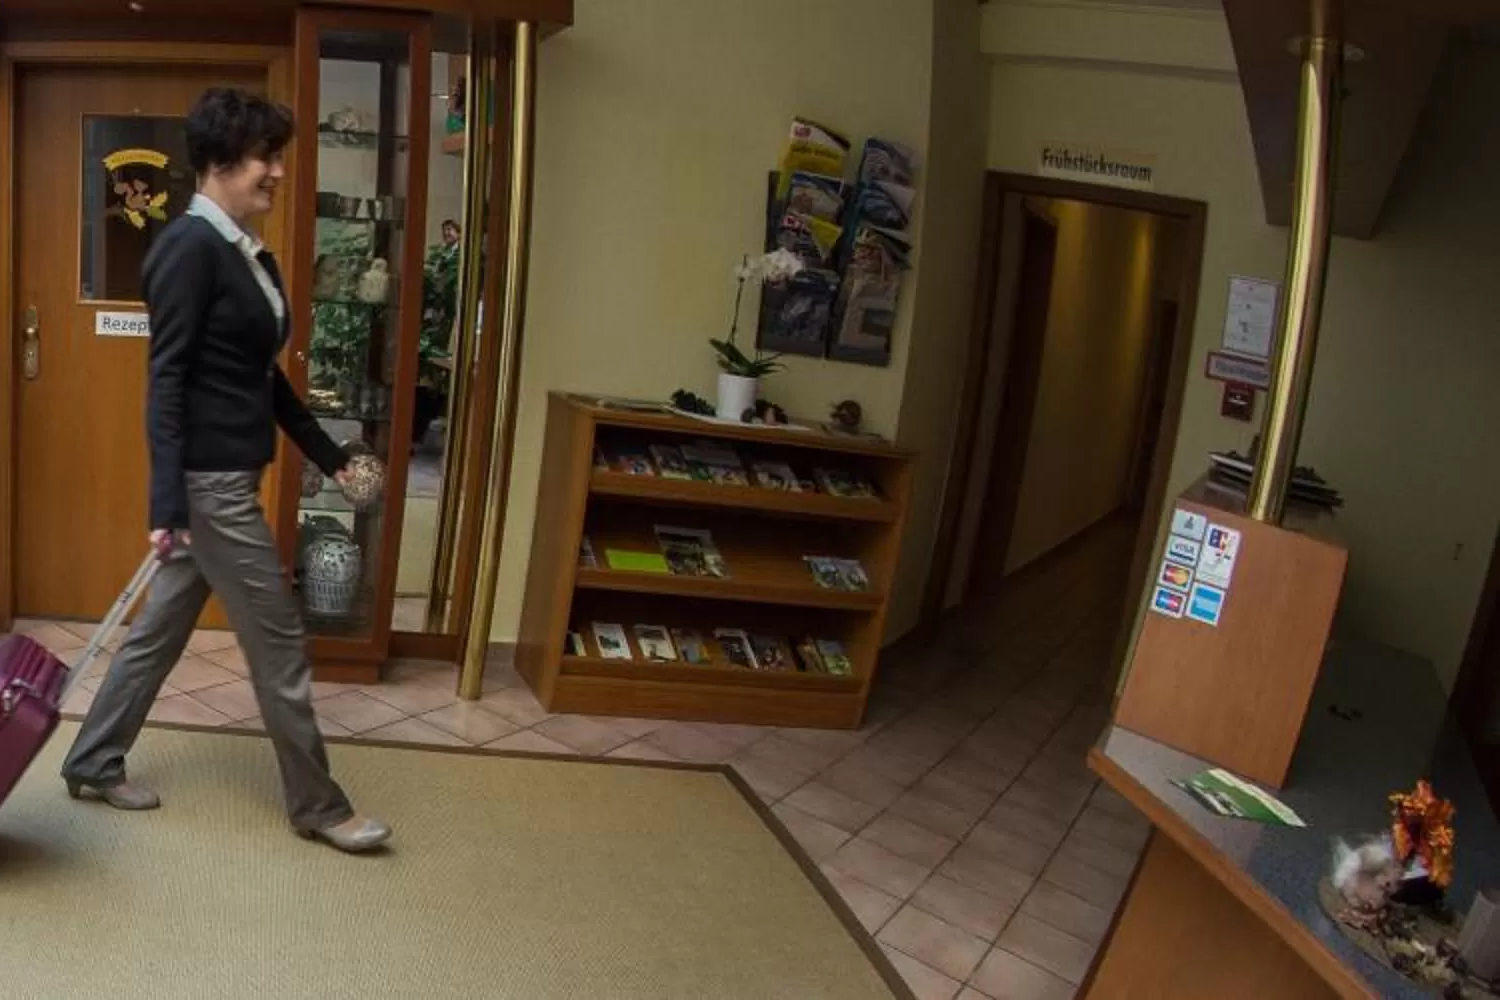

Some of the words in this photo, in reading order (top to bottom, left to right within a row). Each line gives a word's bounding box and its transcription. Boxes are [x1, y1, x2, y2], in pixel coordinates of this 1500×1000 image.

[1042, 148, 1153, 182] Frühstücksraum
[102, 317, 149, 334] Rezep
[1174, 543, 1195, 554] VISA
